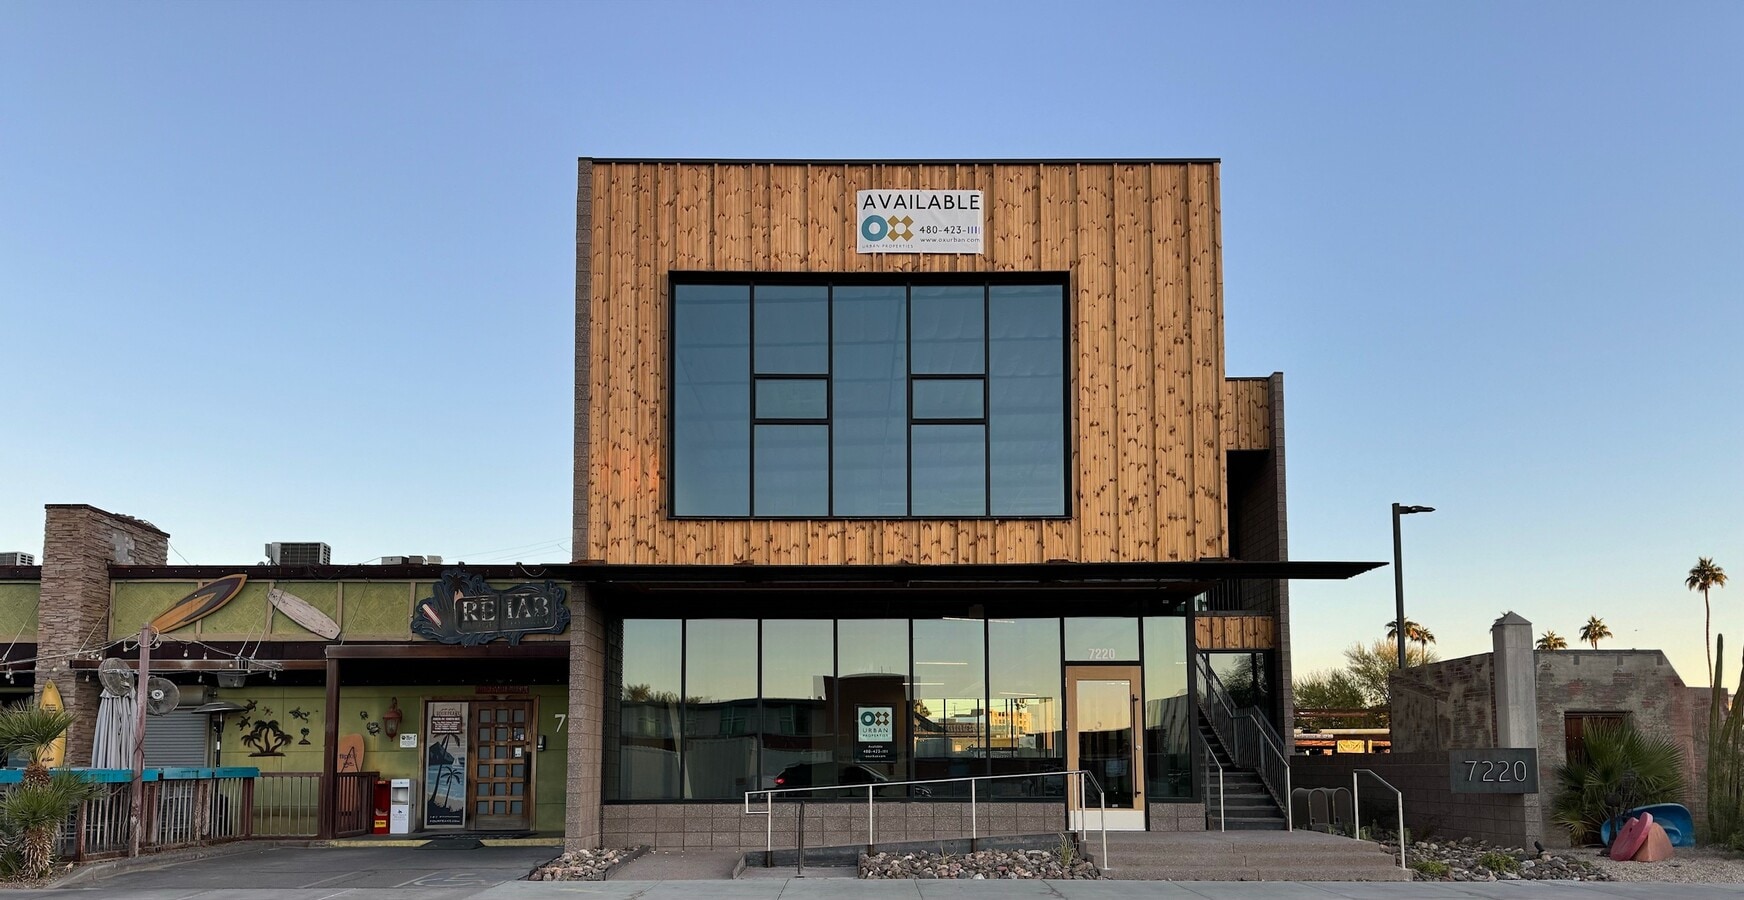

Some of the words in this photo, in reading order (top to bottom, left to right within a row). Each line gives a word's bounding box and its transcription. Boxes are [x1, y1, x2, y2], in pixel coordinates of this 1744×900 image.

[862, 194, 980, 210] AVAILABLE
[1088, 648, 1116, 660] 7220
[554, 713, 567, 733] 7
[1464, 760, 1527, 782] 7220
